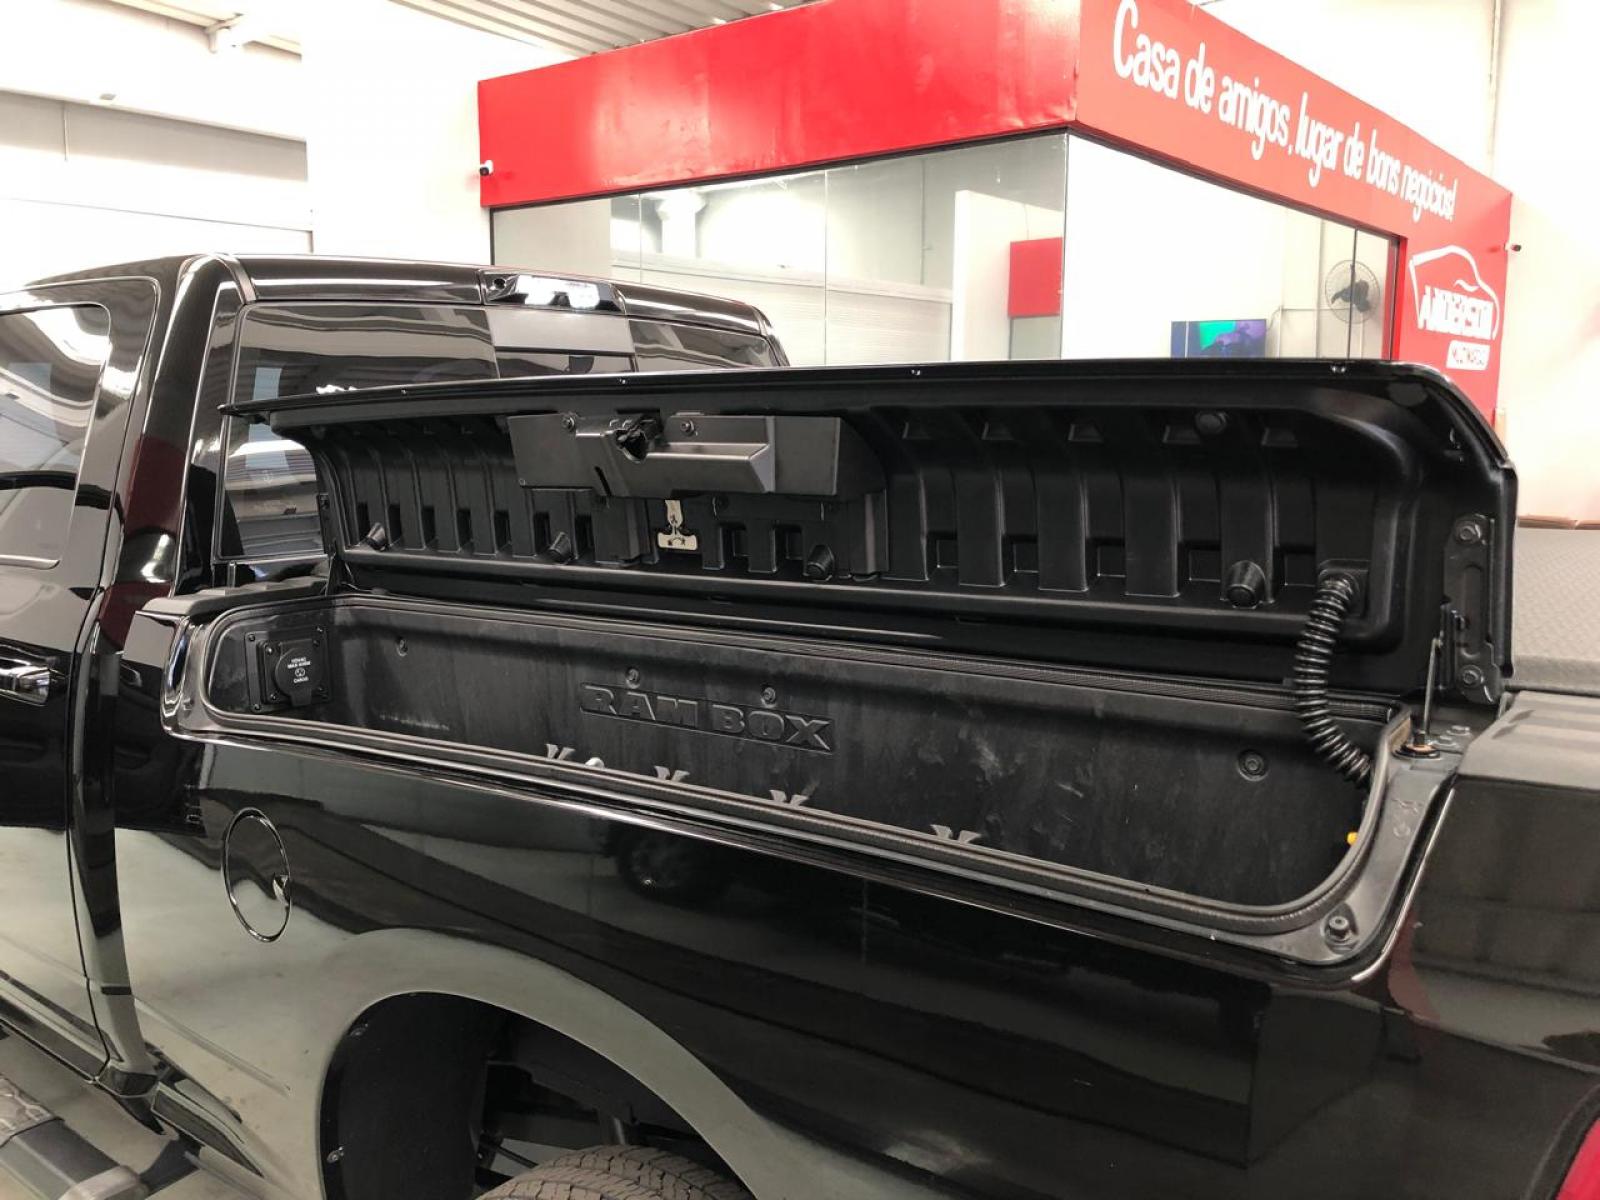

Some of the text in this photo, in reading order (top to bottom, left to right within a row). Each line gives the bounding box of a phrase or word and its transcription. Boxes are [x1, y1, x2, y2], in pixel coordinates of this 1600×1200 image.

[1113, 0, 1181, 100] Casa
[1184, 41, 1215, 114] de
[1218, 77, 1293, 161] amigos,
[1295, 92, 1345, 188] lugar
[1343, 121, 1365, 180] de
[1366, 129, 1401, 196] bons
[580, 684, 832, 752] RAM BOX
